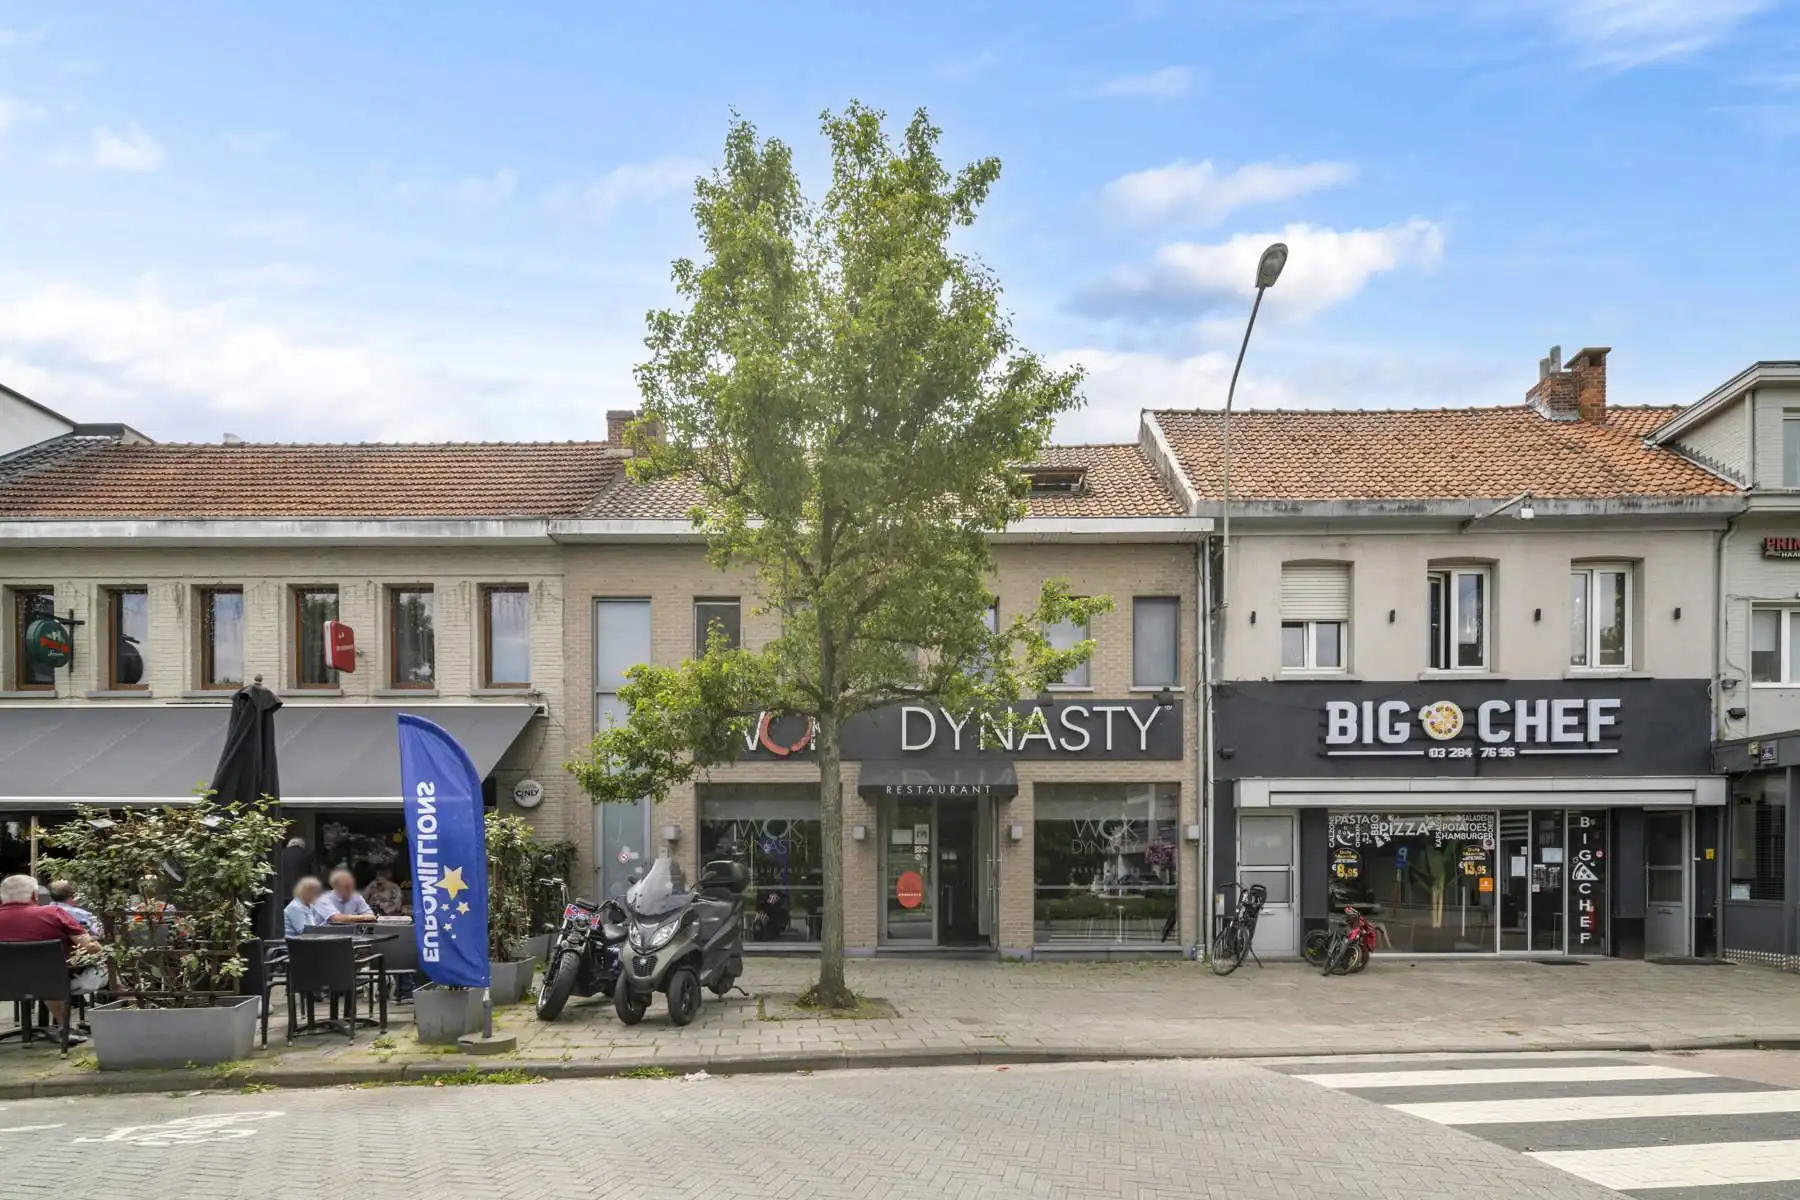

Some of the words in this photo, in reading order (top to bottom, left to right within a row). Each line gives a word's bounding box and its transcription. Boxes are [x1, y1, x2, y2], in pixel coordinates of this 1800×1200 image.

[1326, 701, 1410, 744] BIG
[1478, 699, 1621, 743] CHEF
[902, 706, 1161, 750] DYNASTY
[1428, 748, 1446, 758] 03
[1448, 747, 1473, 758] 284
[1480, 747, 1497, 758] 76
[1498, 747, 1516, 757] 96
[886, 785, 991, 795] RESTAURANT
[1335, 815, 1370, 825] PASTA
[1380, 822, 1430, 836] PIZZA
[1442, 822, 1487, 832] POTATOES
[1441, 832, 1494, 840] HAMBURGER
[1578, 816, 1592, 861] BIG
[1578, 882, 1593, 944] CHEF
